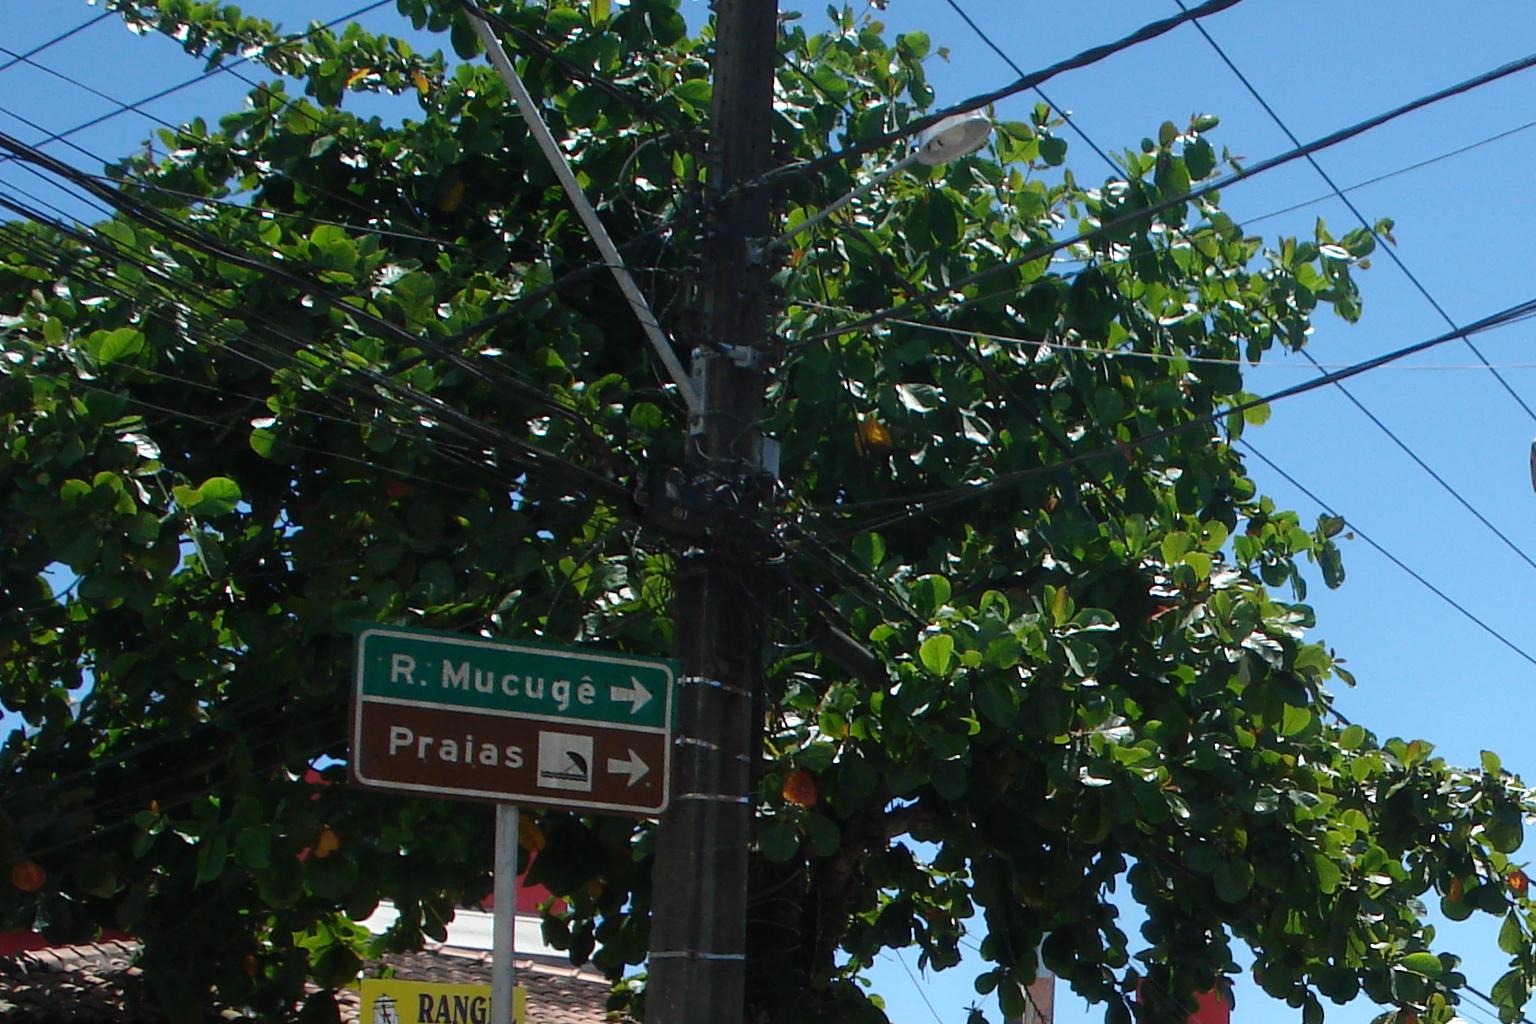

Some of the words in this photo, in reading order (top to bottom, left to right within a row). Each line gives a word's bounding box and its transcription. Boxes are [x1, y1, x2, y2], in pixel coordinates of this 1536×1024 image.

[390, 653, 428, 687] R.
[441, 658, 597, 712] Mucugê
[389, 725, 525, 769] Praias
